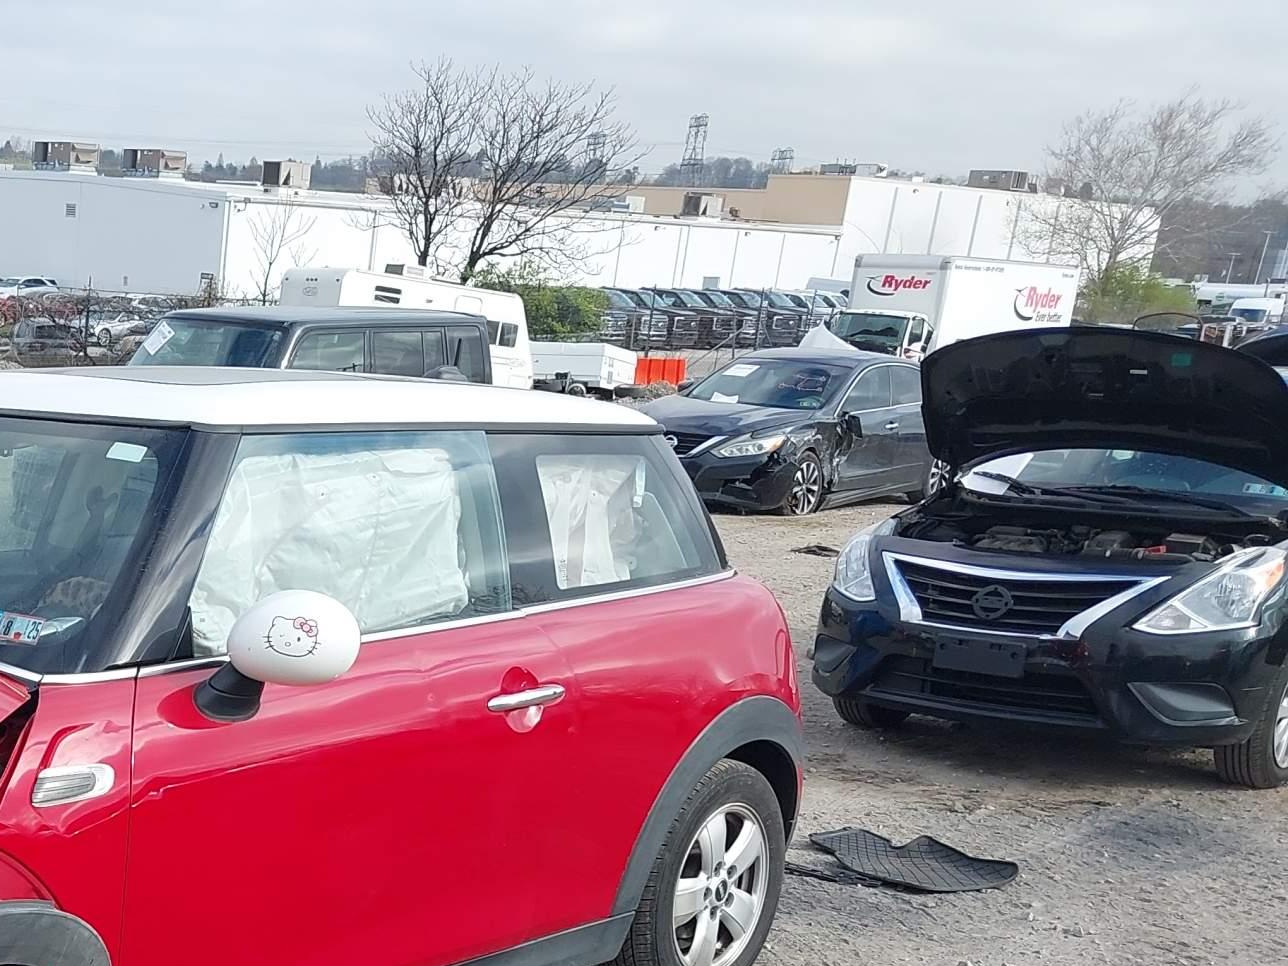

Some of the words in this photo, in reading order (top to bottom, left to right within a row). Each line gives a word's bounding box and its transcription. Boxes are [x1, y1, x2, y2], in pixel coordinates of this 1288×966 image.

[881, 275, 932, 291] Ryder
[1024, 286, 1063, 313] Ryder
[3, 620, 13, 636] 8
[27, 621, 42, 640] 25
